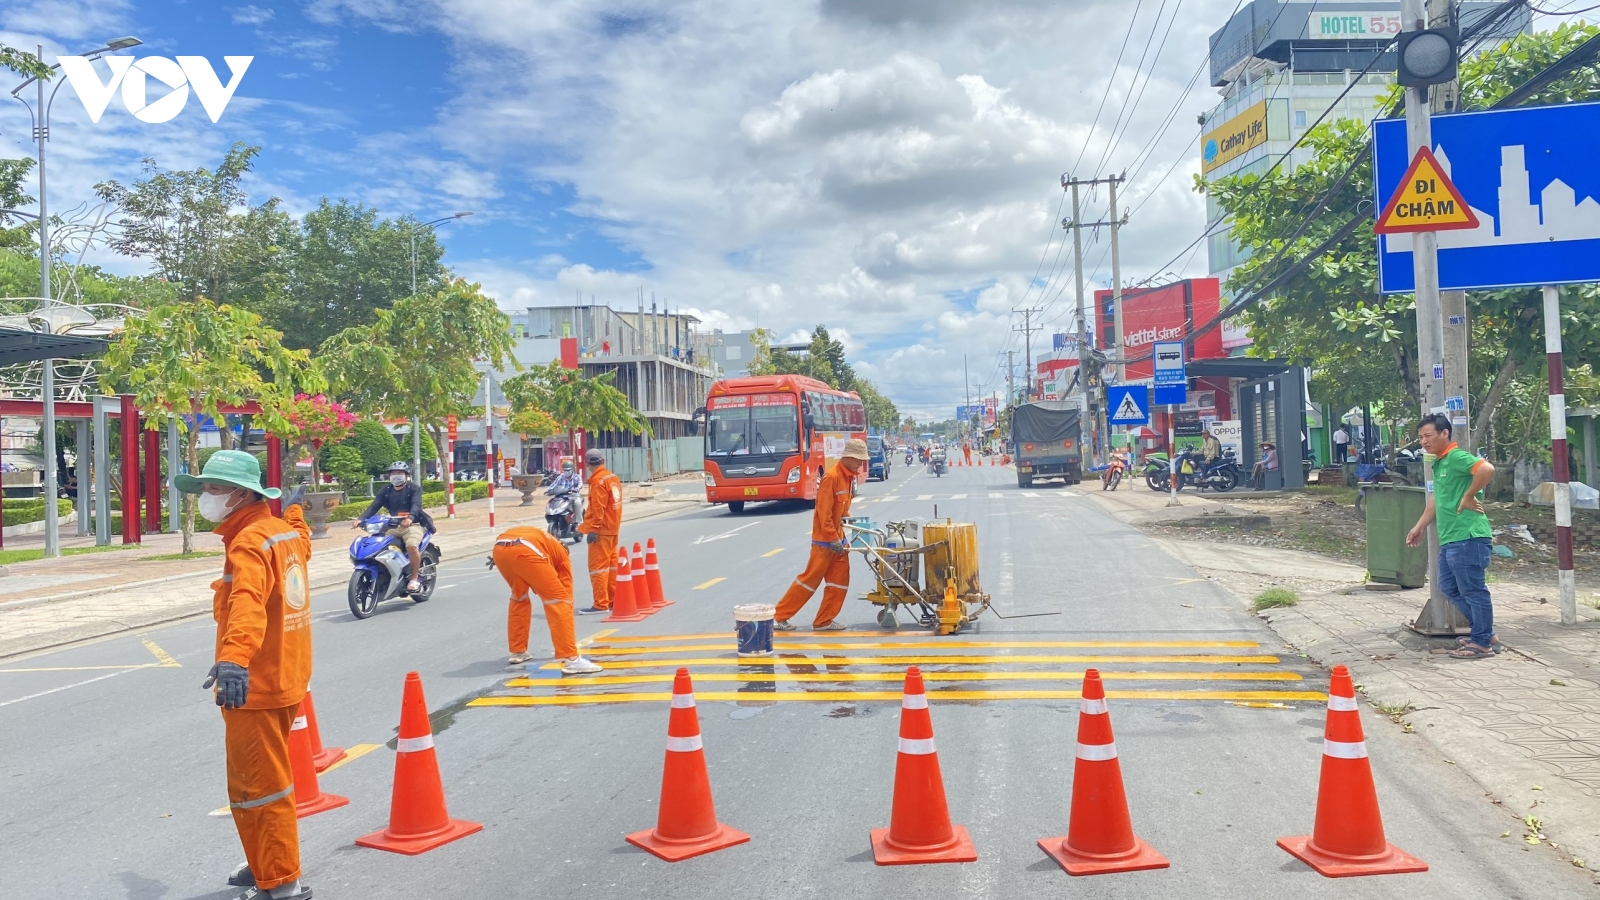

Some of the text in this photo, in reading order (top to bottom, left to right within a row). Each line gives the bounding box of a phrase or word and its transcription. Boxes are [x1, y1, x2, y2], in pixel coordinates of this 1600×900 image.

[1321, 16, 1402, 34] HOTEL 55
[1221, 119, 1263, 153] Cathay Life
[1415, 179, 1436, 194] ĐI
[1395, 197, 1454, 220] CHẬM
[1213, 427, 1236, 436] OPPO
